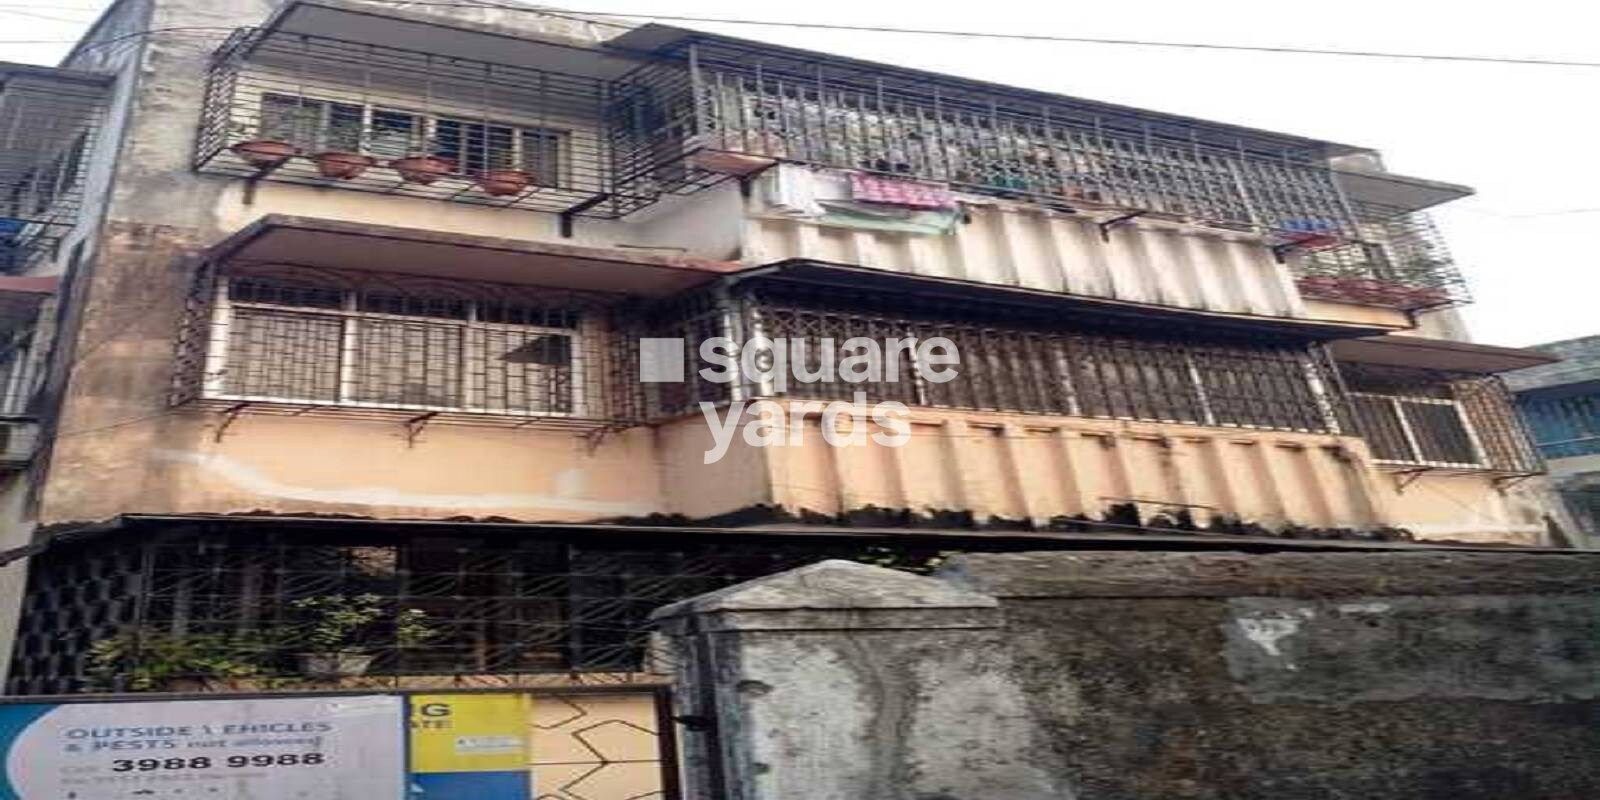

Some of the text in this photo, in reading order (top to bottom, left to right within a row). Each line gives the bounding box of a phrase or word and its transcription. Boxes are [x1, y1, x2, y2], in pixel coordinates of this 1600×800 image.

[65, 725, 193, 740] OUTSIDE
[112, 757, 212, 773] 3988
[227, 752, 324, 768] 9988
